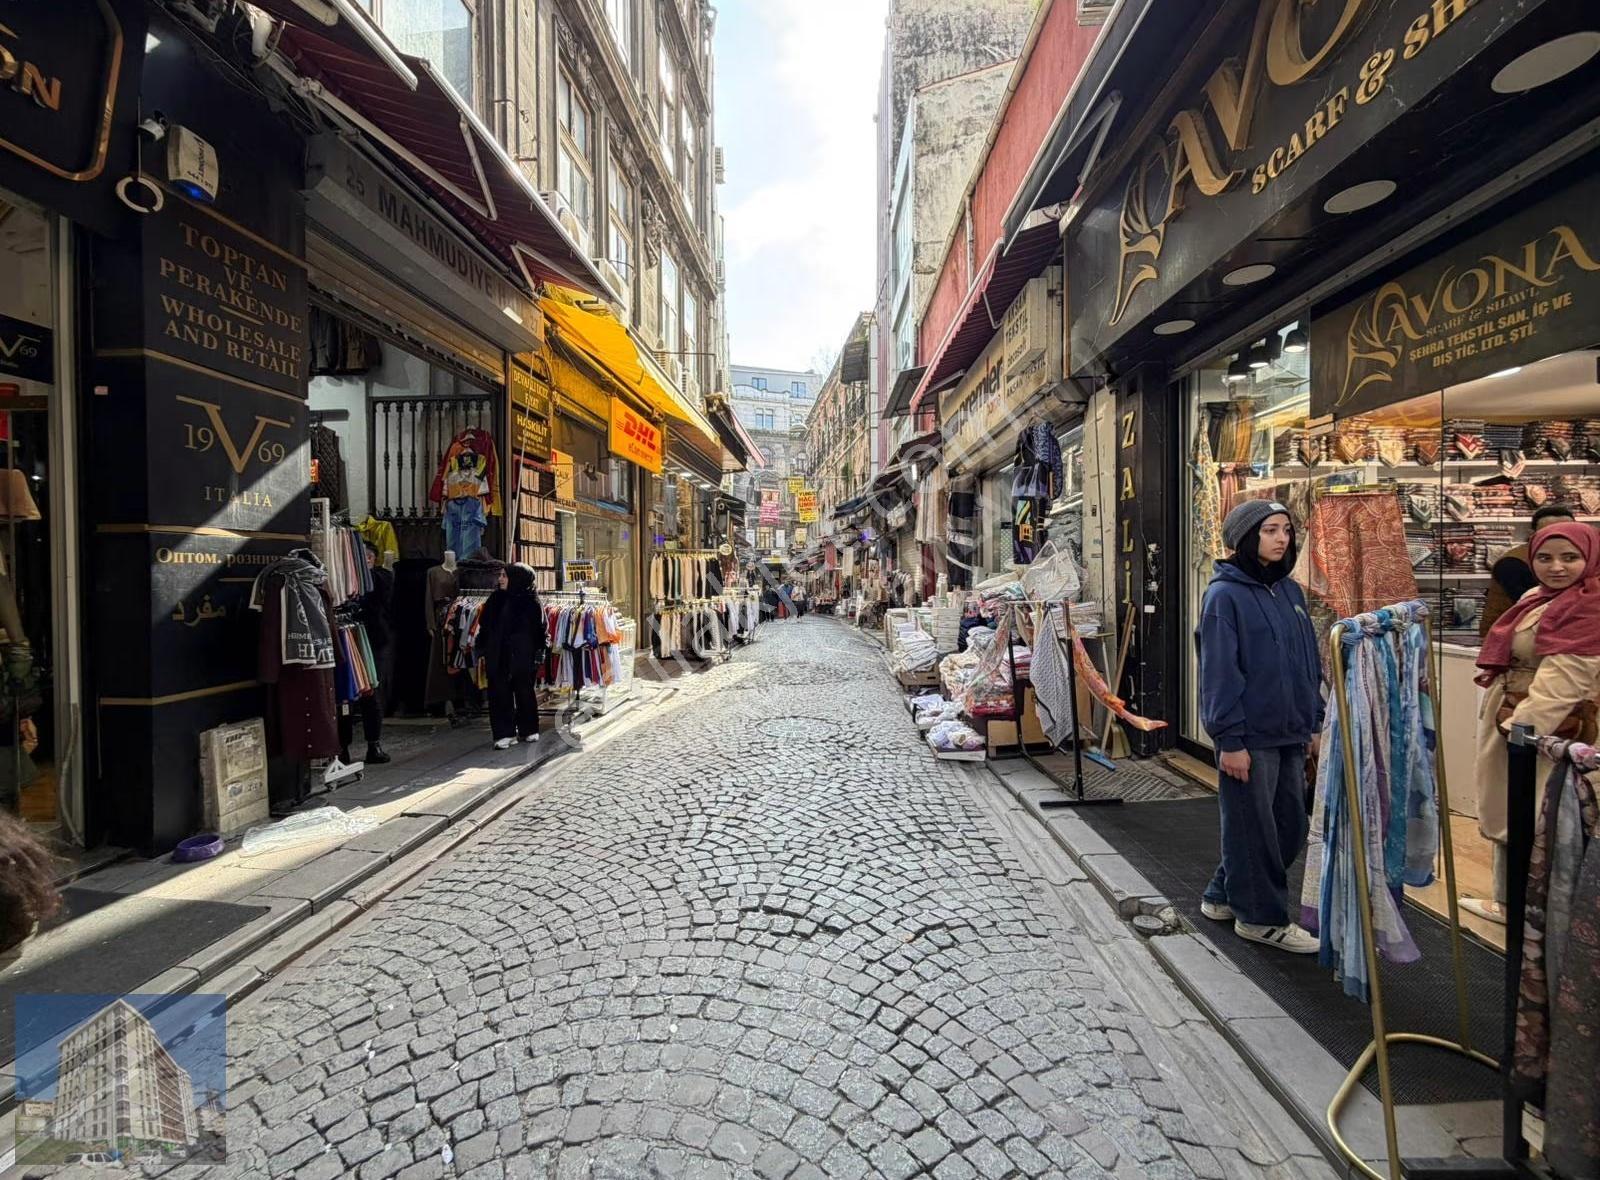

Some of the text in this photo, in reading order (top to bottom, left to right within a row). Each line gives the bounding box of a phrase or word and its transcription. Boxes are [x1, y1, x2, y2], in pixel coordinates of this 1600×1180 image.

[1251, 86, 1350, 195] SCARF
[1355, 48, 1396, 105] &
[179, 222, 287, 292] TOPTAN
[223, 265, 253, 294] VE
[1386, 226, 1600, 343] AVONA
[159, 256, 302, 334] PERAKENDE
[1447, 318, 1495, 348] TEKSTİL
[1498, 311, 1530, 332] SAN.
[1533, 300, 1550, 318] İÇ
[1552, 292, 1573, 311] VE
[160, 294, 301, 362] WHOLESALE
[165, 319, 300, 379] AND RETAIL
[1456, 343, 1479, 360] TİC.
[1481, 333, 1507, 351] LTD.
[1510, 321, 1538, 344] ŞTİ.
[623, 411, 657, 451] DHL
[204, 486, 273, 508] ITALIA
[568, 570, 587, 582] 100
